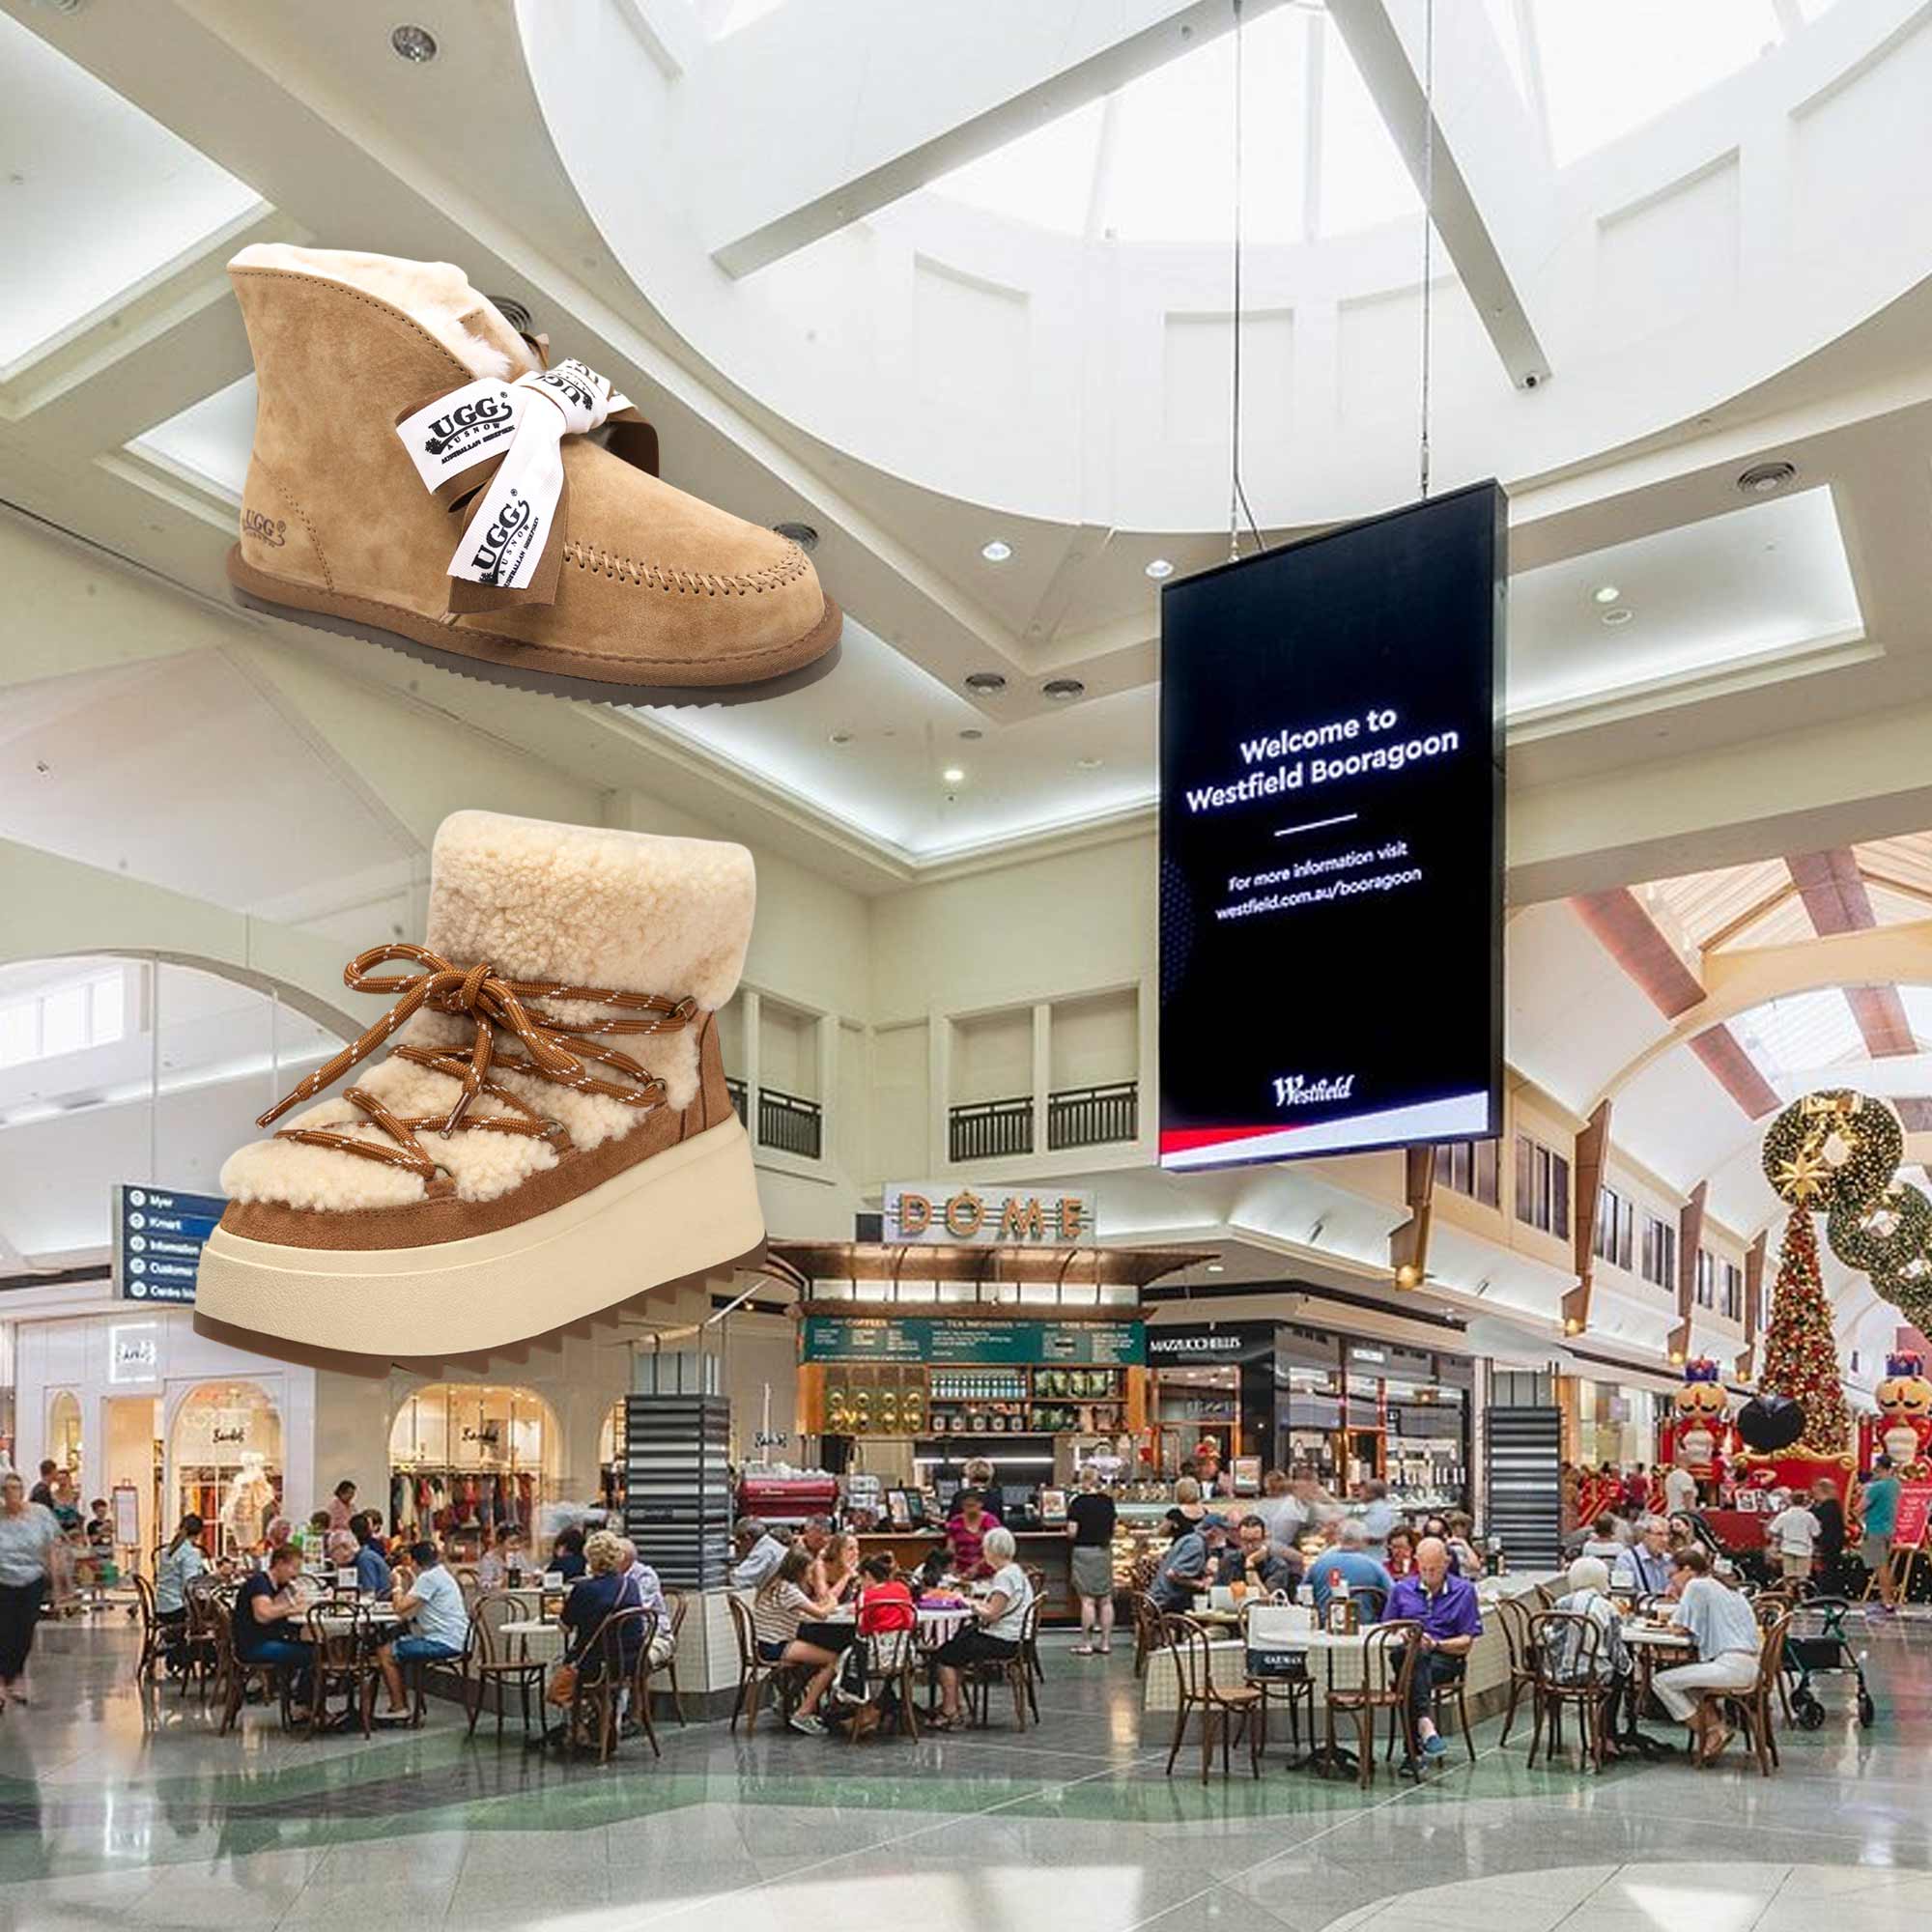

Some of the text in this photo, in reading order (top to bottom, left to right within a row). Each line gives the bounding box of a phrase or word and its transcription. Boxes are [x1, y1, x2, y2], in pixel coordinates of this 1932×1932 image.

[428, 397, 498, 438] UGG
[447, 423, 500, 450] AUSNOW
[471, 503, 521, 570] UGG
[497, 524, 529, 577] AUSNOW
[1240, 709, 1398, 765] Welcome to
[1186, 731, 1460, 812] Westfield Booragoon
[1254, 867, 1291, 887] more
[1293, 849, 1374, 879] information
[1378, 840, 1408, 861] visit
[1215, 867, 1422, 920] westfield.com.au/booragoon
[1272, 1074, 1355, 1107] Westfield
[898, 1190, 1083, 1239] DOME
